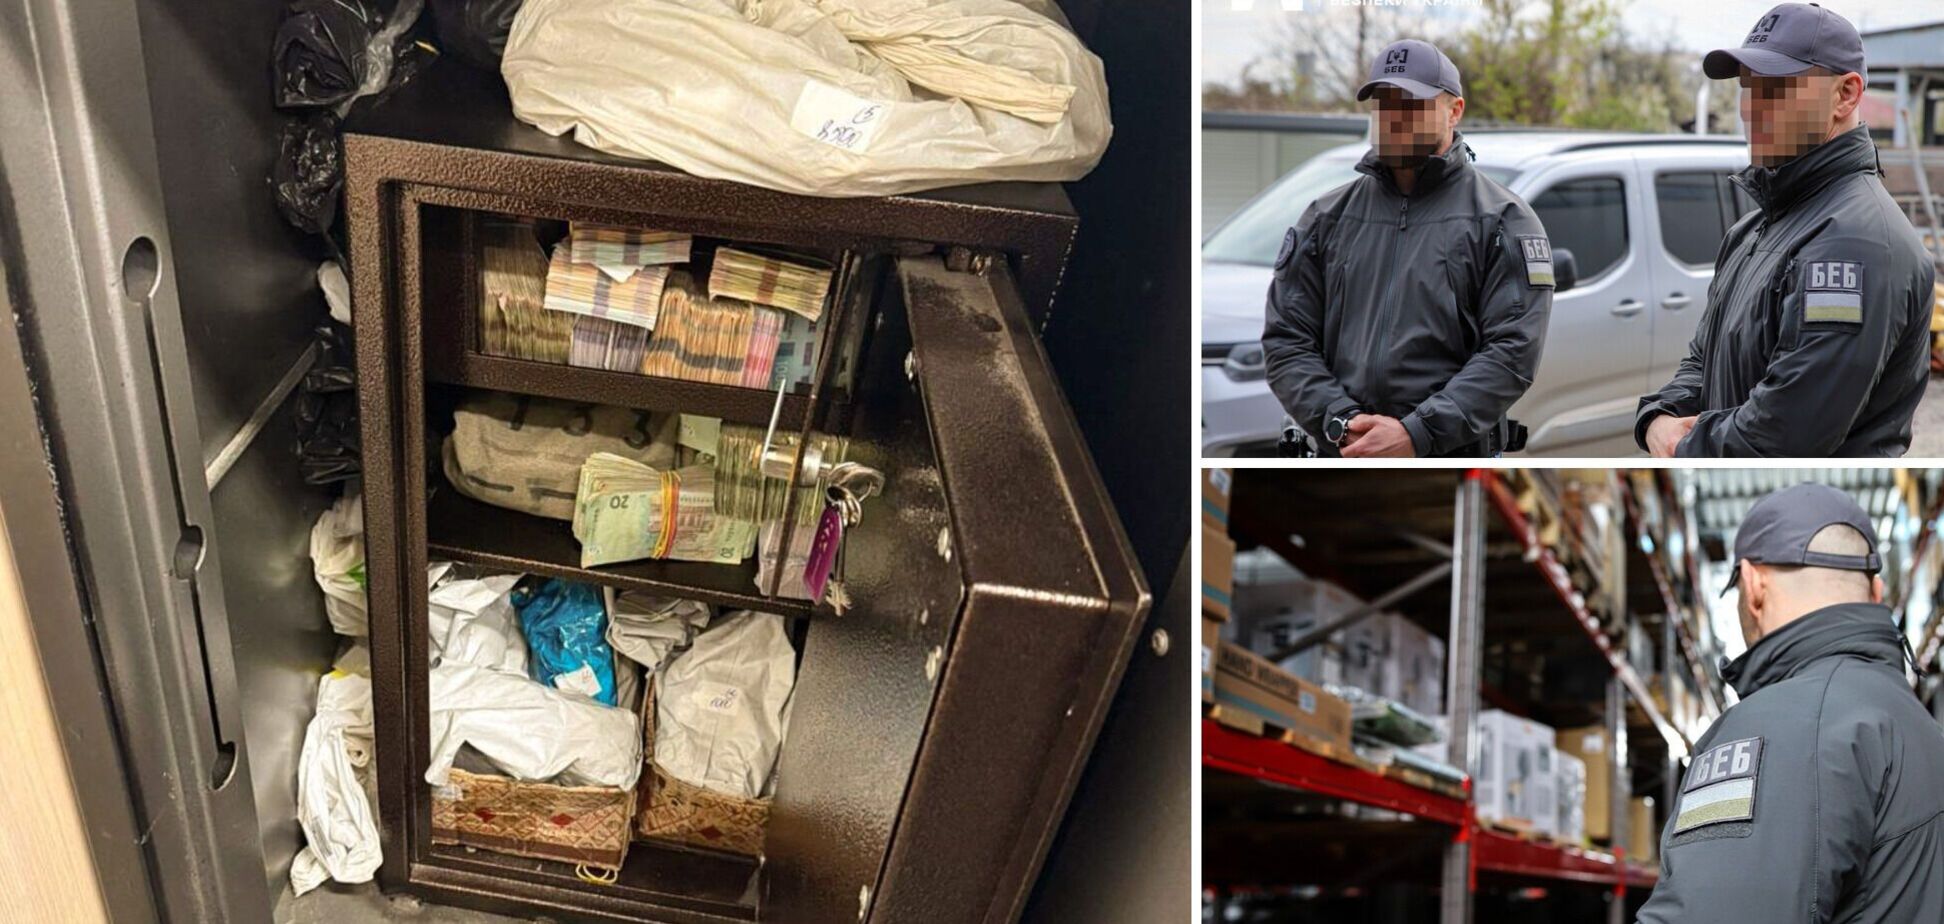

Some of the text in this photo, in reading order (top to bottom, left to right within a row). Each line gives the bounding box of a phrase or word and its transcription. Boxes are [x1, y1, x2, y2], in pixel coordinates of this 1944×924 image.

[1384, 65, 1406, 74] БЕБ
[1523, 239, 1550, 259] БЕБ
[1811, 262, 1857, 289] БЕБ
[609, 494, 629, 509] 20
[1693, 741, 1751, 785] БЕБ
